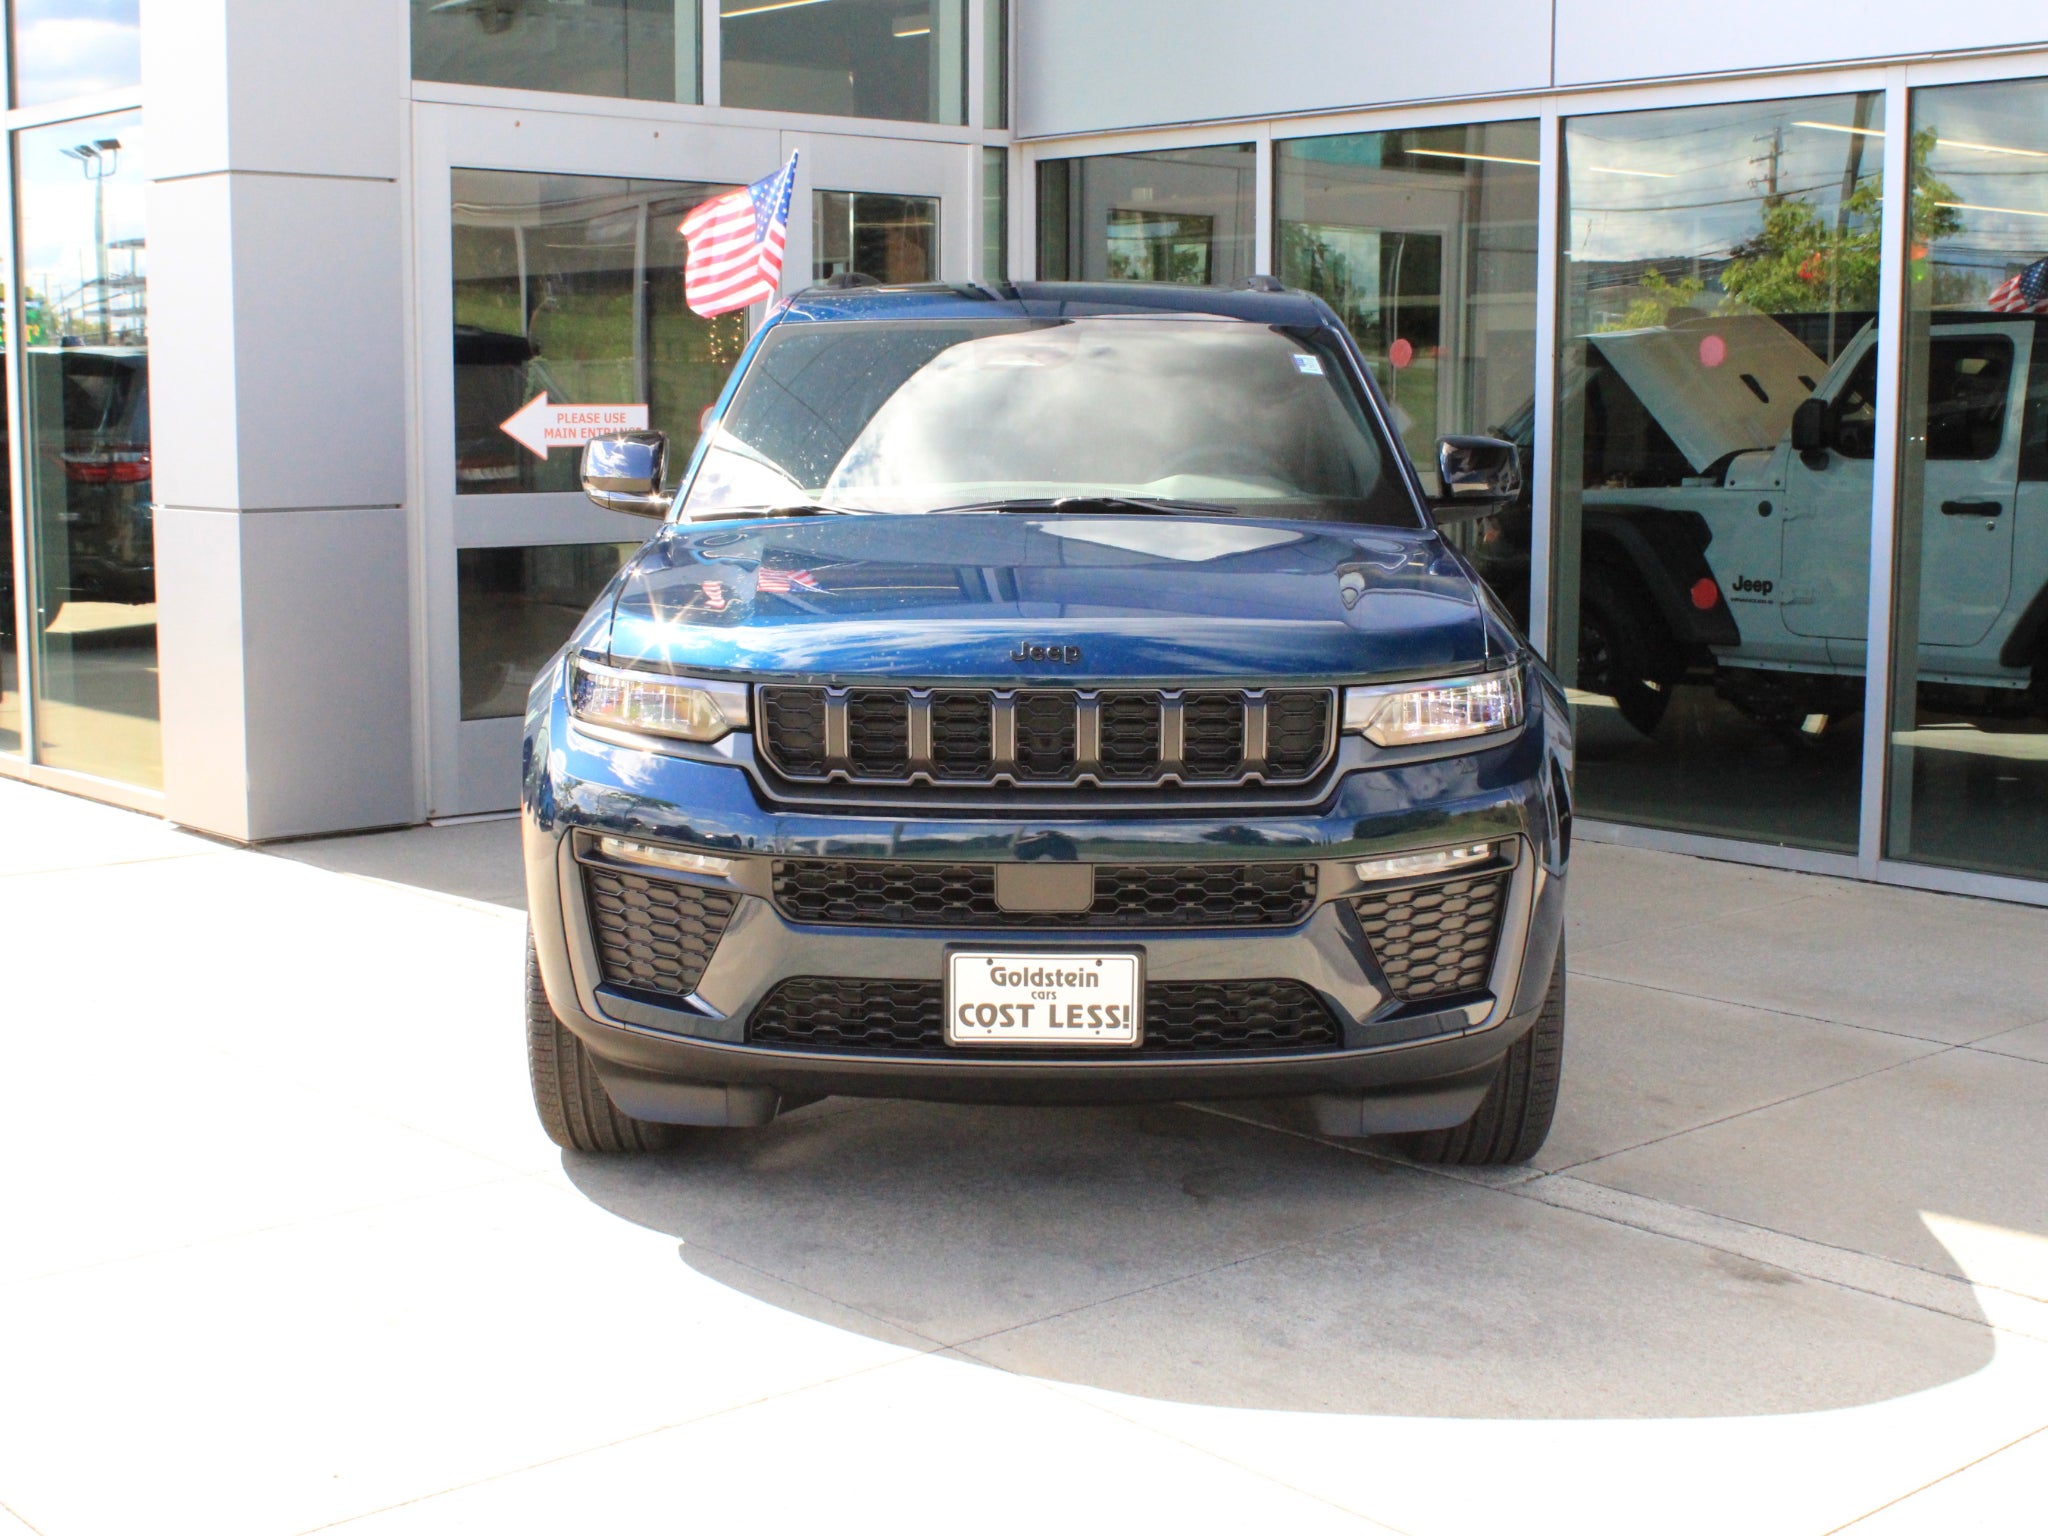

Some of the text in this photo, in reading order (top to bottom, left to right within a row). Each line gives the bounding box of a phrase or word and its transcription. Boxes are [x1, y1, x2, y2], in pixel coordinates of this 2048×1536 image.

[557, 412, 626, 424] PLEASE USE
[544, 428, 577, 439] MAIN
[1732, 575, 1773, 596] Jeep
[1009, 641, 1080, 665] Jeep
[990, 966, 1099, 988] Goldstein
[1031, 990, 1057, 1000] cars
[958, 1003, 1130, 1029] COST LESS!
